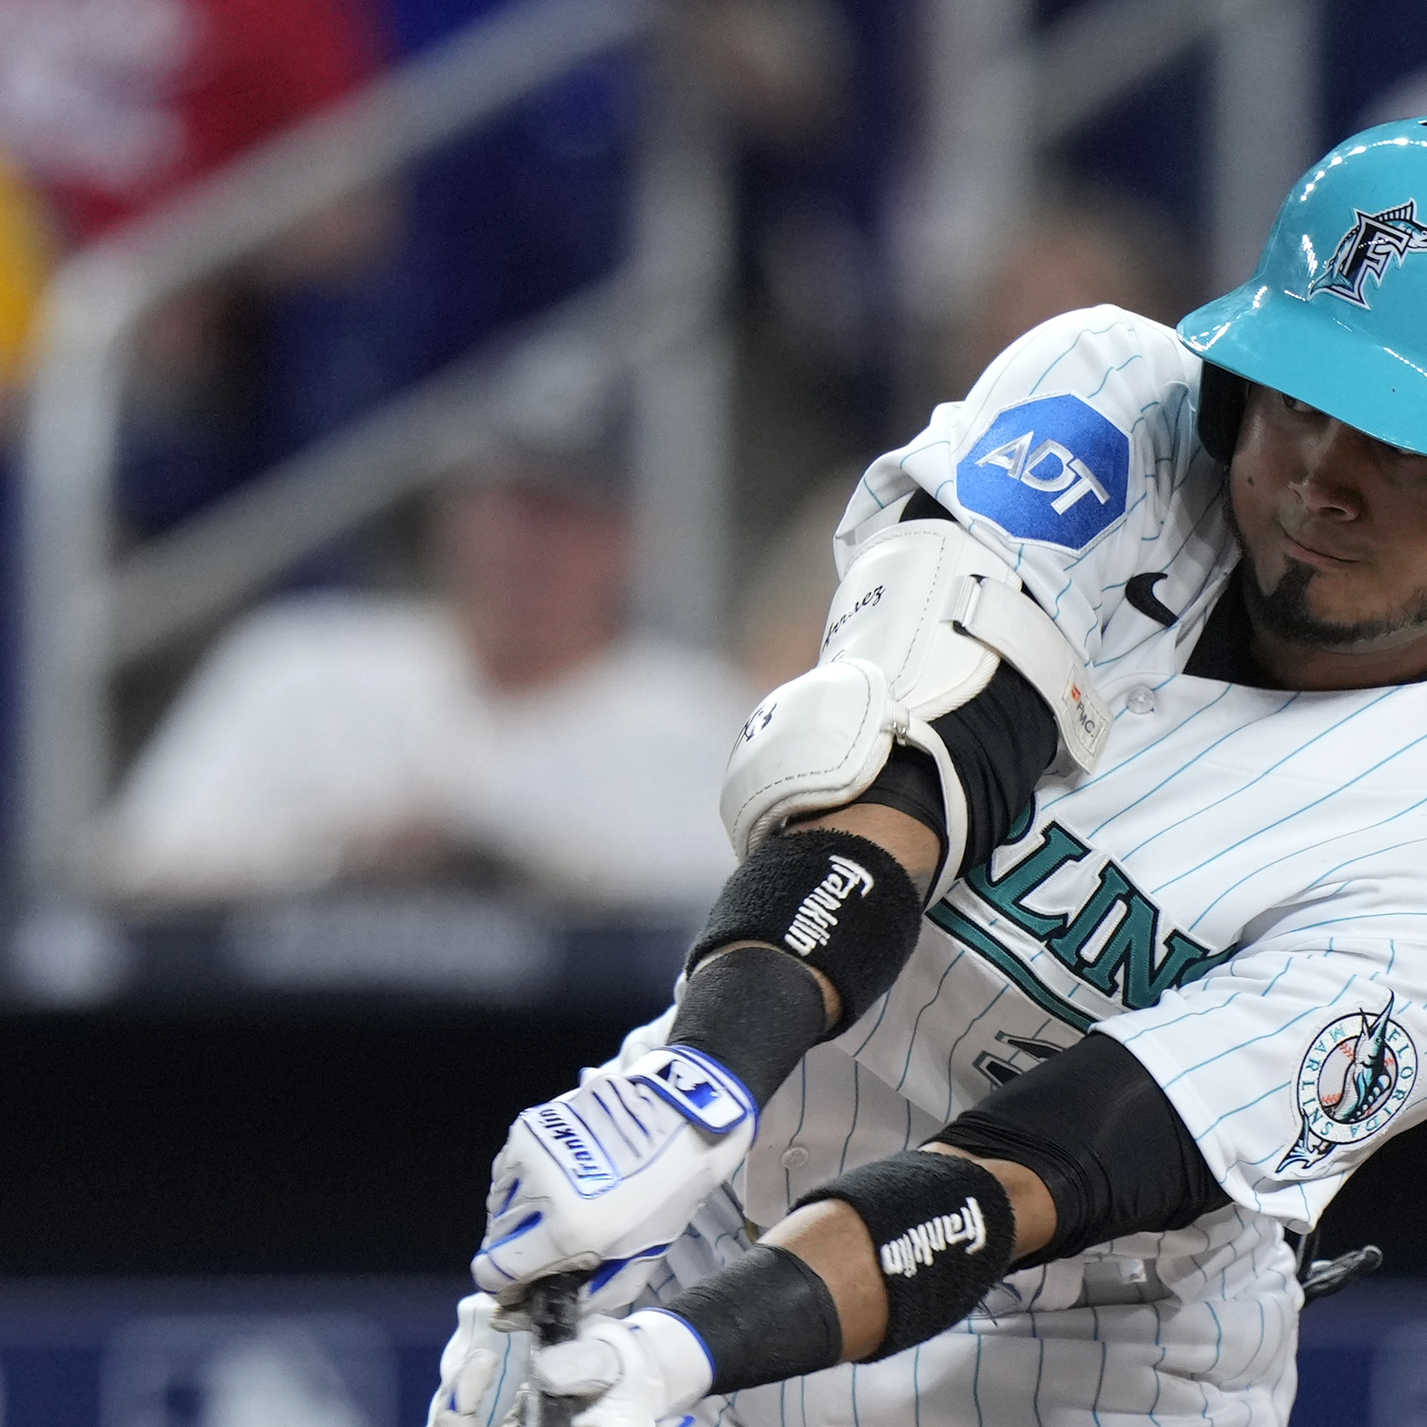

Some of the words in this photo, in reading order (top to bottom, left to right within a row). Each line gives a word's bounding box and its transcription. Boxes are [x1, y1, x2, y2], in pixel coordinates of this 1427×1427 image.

[975, 430, 1111, 516] ADT
[784, 854, 874, 957] Franklin
[1350, 1027, 1415, 1138] FLORIDA
[539, 1108, 612, 1182] Franklin
[880, 1196, 987, 1278] Franklin
